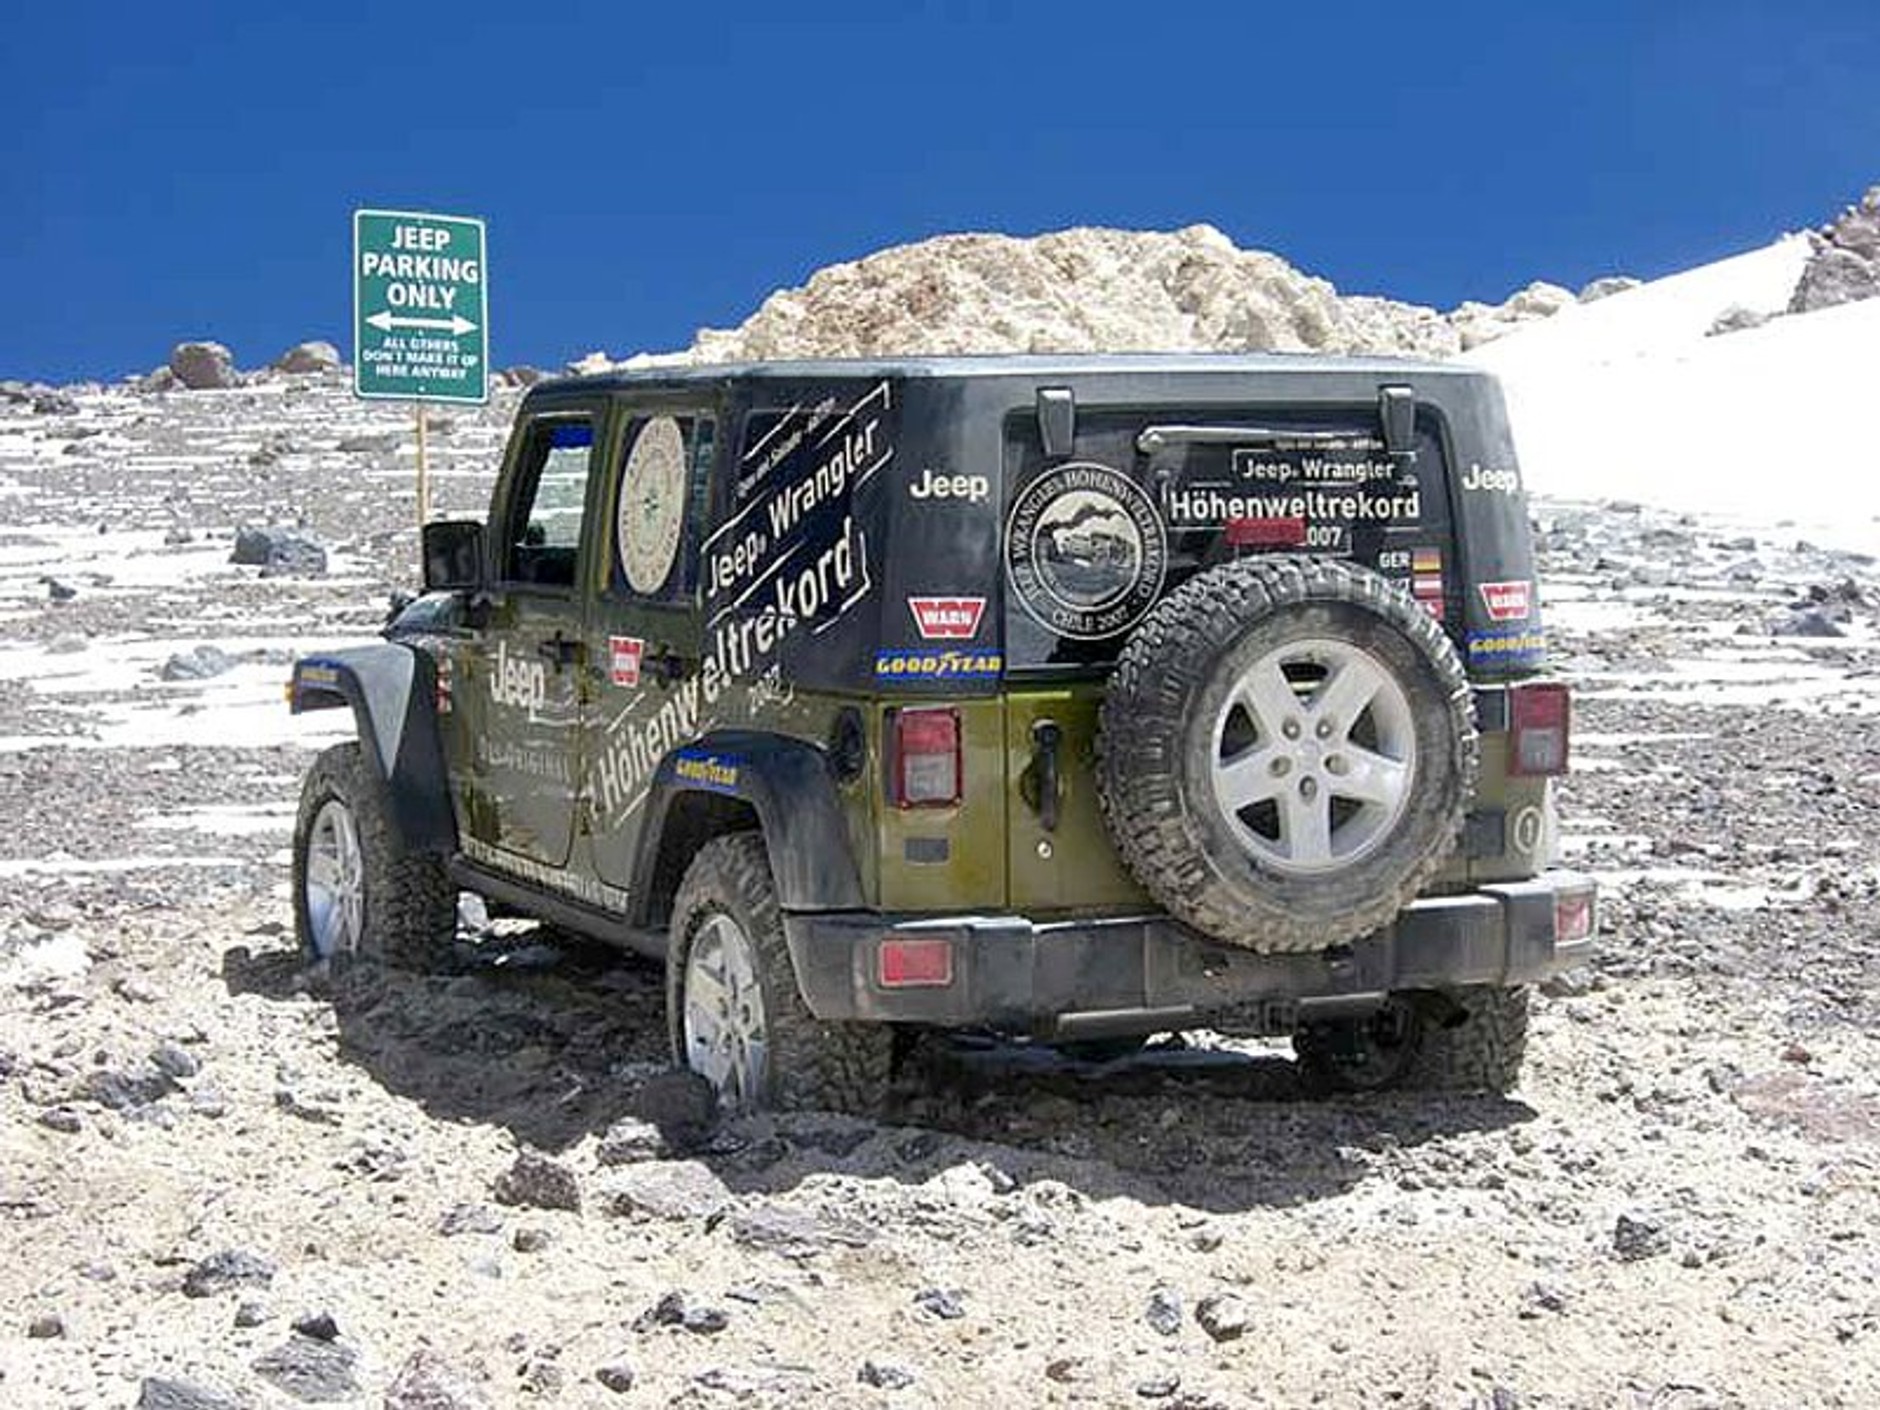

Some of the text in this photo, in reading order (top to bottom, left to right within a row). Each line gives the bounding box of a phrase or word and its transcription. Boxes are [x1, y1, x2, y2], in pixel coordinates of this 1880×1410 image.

[391, 225, 450, 251] JEEP
[362, 253, 478, 283] PARKING
[387, 281, 457, 309] ONLY
[383, 337, 459, 352] ALL OTHERS
[375, 365, 467, 379] HERE ANYWAY
[406, 352, 443, 365] MAKE
[447, 354, 459, 365] IT
[461, 355, 478, 368] UP
[768, 418, 879, 540] Wrangler
[1301, 458, 1396, 483] Wrangler
[1462, 464, 1517, 496] Jeep
[908, 469, 989, 502] Jeep
[1170, 491, 1421, 520] Höhenweltrekord
[1296, 526, 1342, 546] 007
[1380, 552, 1410, 568] GER
[921, 609, 974, 626] WARN
[598, 515, 853, 815] Höhenweltrekord
[876, 653, 1001, 675] GOODYEAR
[490, 639, 545, 722] Jeep
